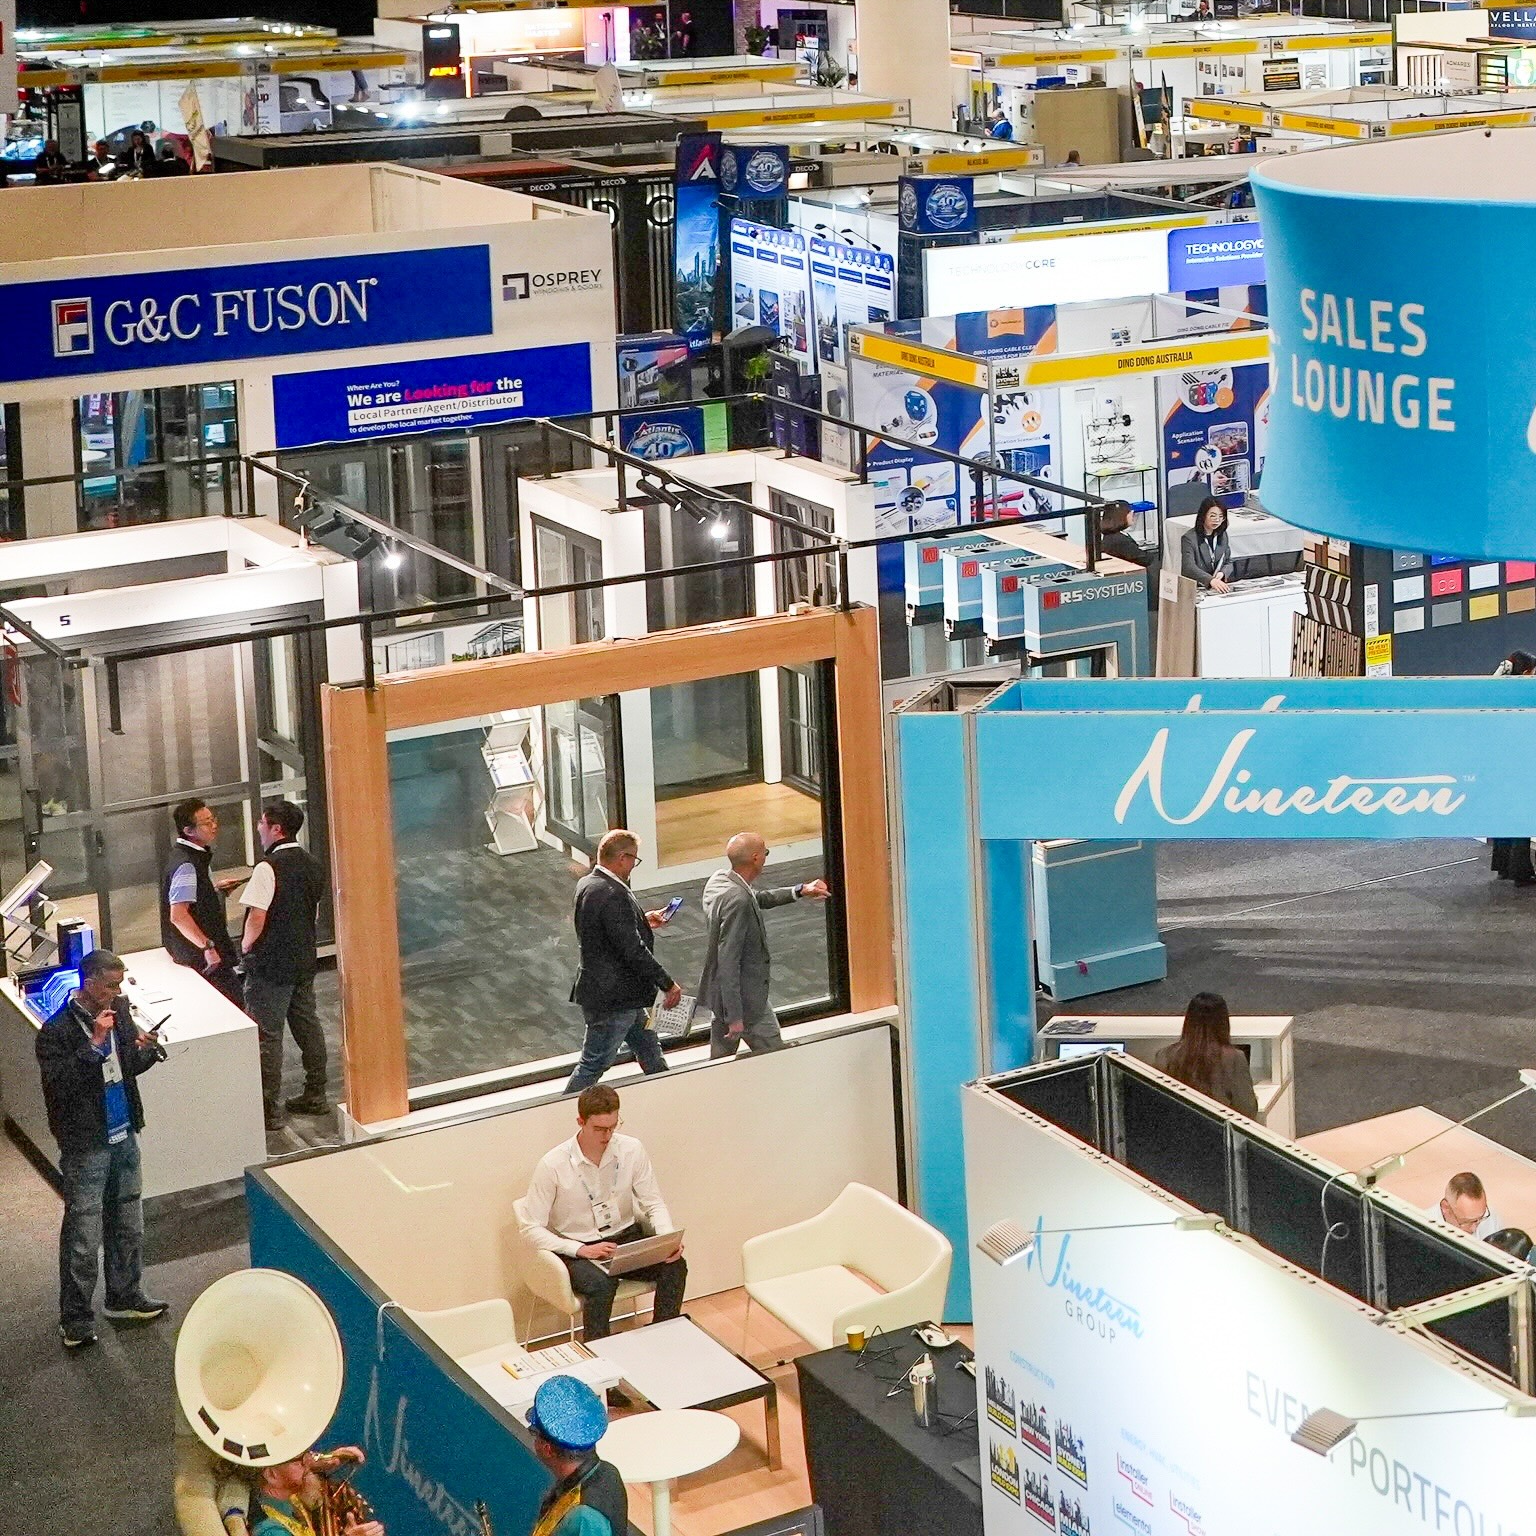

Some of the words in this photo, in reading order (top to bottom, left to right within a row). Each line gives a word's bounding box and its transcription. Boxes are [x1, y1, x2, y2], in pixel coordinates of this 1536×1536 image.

[533, 269, 601, 287] OSPREY
[105, 294, 200, 345] G&C
[1300, 287, 1427, 357] SALES
[1118, 358, 1133, 370] DING
[1135, 356, 1155, 368] DONG
[1156, 352, 1193, 366] AUSTRALIA
[347, 383, 369, 392] Where
[347, 394, 372, 407] We
[375, 391, 401, 403] are
[405, 383, 469, 401] Looking
[470, 380, 494, 394] for
[496, 377, 523, 391] the
[1290, 358, 1457, 432] LOUNGE
[353, 411, 382, 421] Local
[384, 395, 518, 418] Partner/Agent/Distributor
[358, 424, 386, 434] develop
[387, 422, 398, 430] the
[399, 420, 416, 429] local
[1172, 430, 1204, 440] Application
[872, 457, 893, 467] Product
[893, 455, 914, 465] Display
[1060, 580, 1144, 604] RS-SYSTEMS
[1114, 728, 1467, 825] Nineteen
[1065, 1299, 1116, 1344] GROUP
[1056, 1444, 1087, 1467] SYDNEY
[991, 1464, 1020, 1490] LONDON
[1120, 1457, 1149, 1486] installer
[1025, 1488, 1055, 1516] CHICAGO
